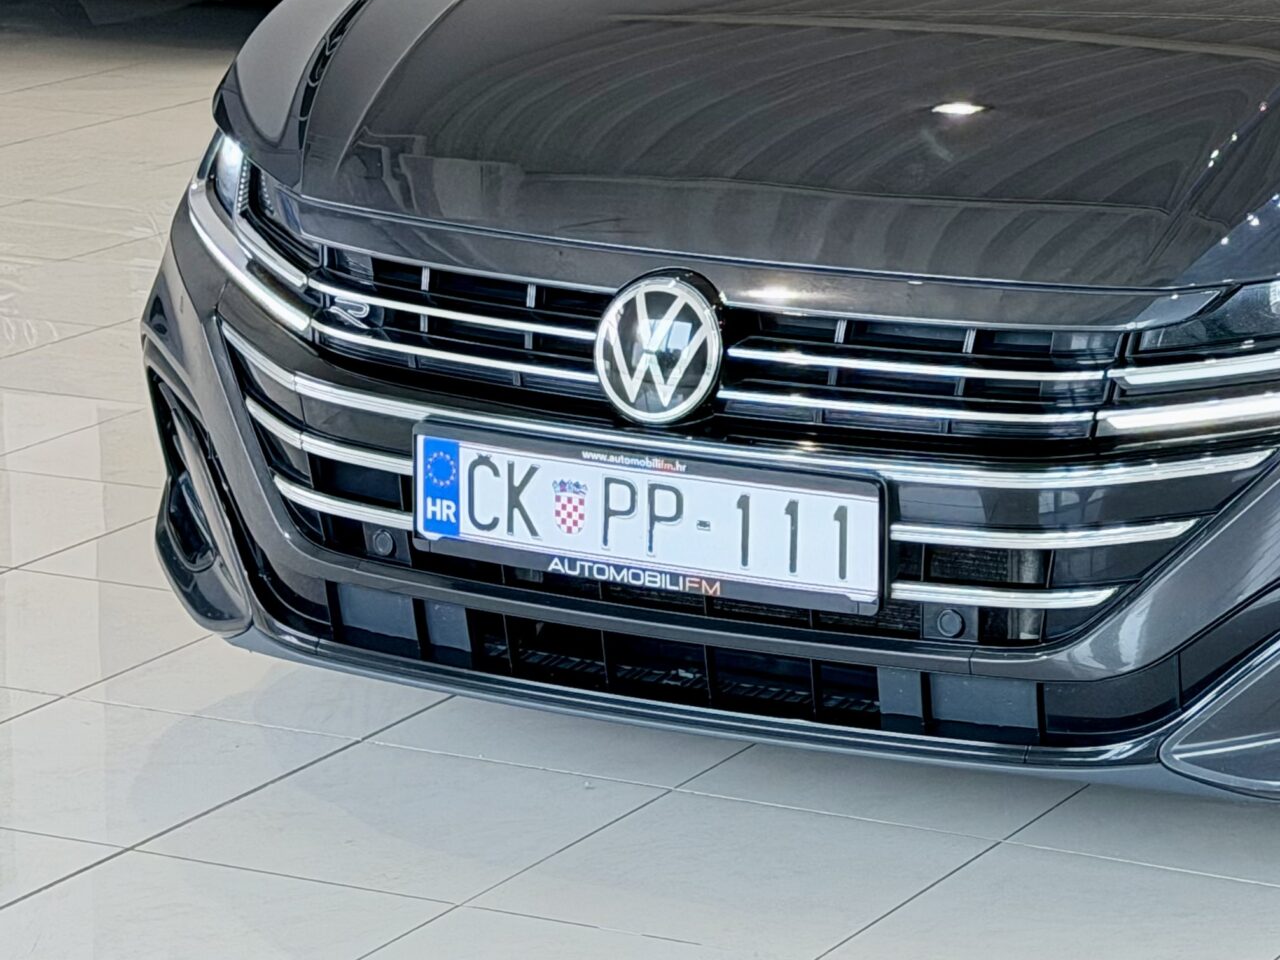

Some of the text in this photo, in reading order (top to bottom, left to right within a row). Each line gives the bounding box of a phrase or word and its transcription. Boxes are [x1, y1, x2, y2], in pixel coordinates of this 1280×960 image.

[604, 288, 712, 410] VW
[581, 450, 687, 472] www.automobilifm.hr
[426, 496, 457, 524] HR
[467, 453, 849, 582] ČK PP-111
[547, 556, 721, 597] AUTOMOBILIFM
